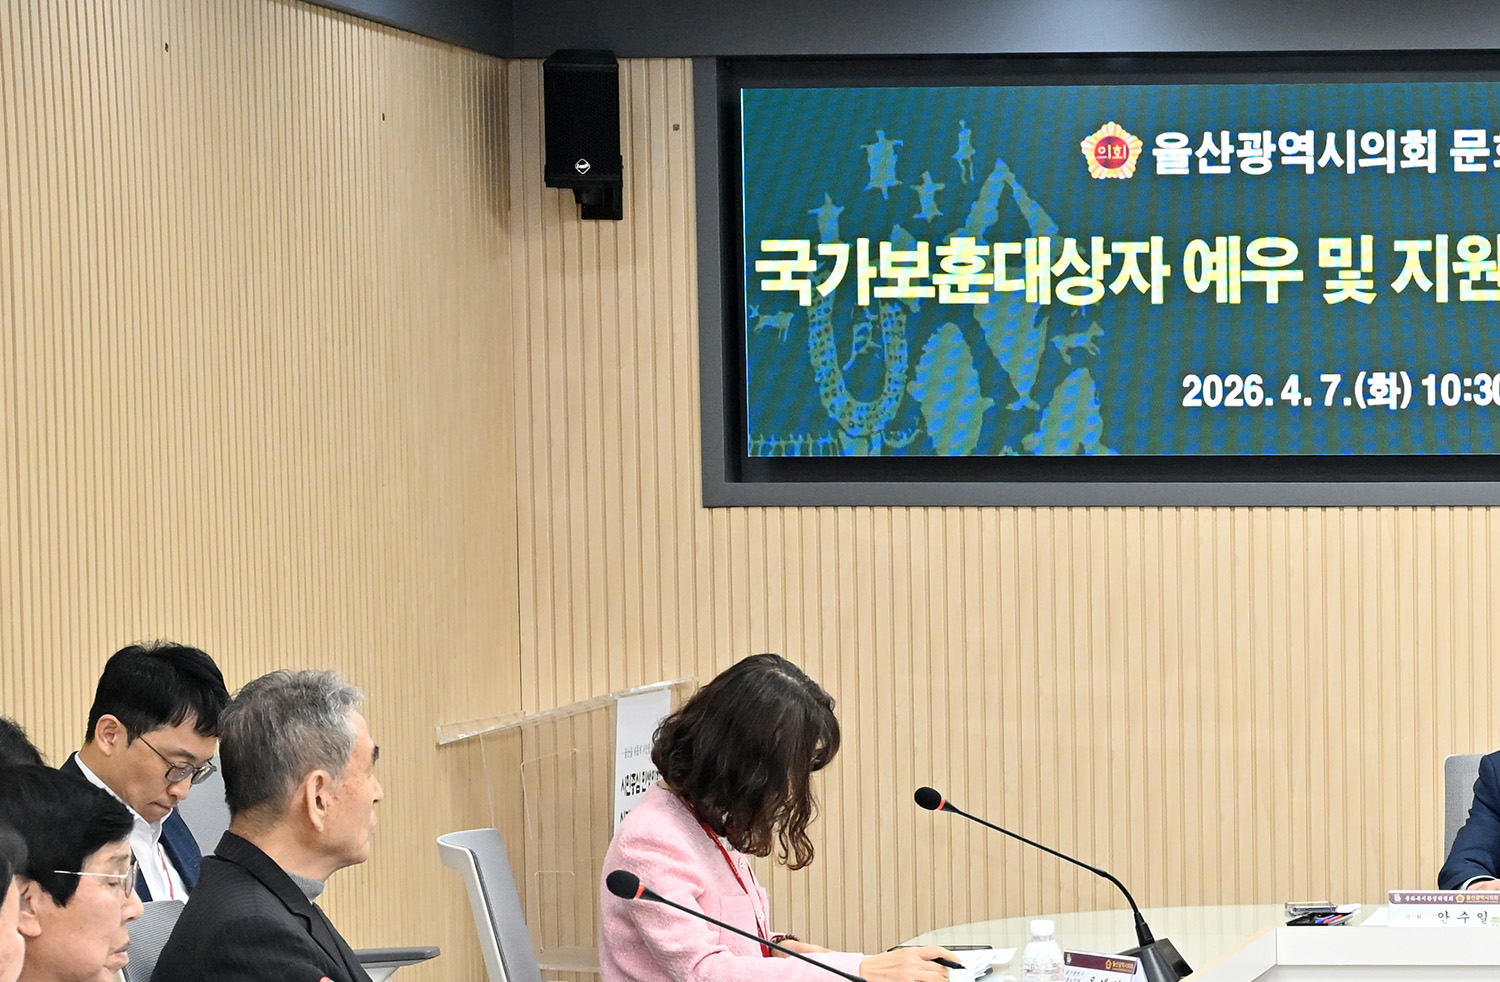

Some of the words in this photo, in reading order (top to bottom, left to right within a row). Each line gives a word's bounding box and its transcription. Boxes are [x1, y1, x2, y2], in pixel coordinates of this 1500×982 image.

[1096, 144, 1127, 160] 의회
[1152, 129, 1437, 175] 울산광역시의회
[754, 235, 1171, 307] 국가보훈대상자
[1183, 235, 1304, 304] 예우
[1318, 234, 1377, 305] 및
[1182, 373, 1274, 408] 2026.
[1280, 374, 1312, 407] 4.
[1320, 370, 1412, 410] 7.(화)
